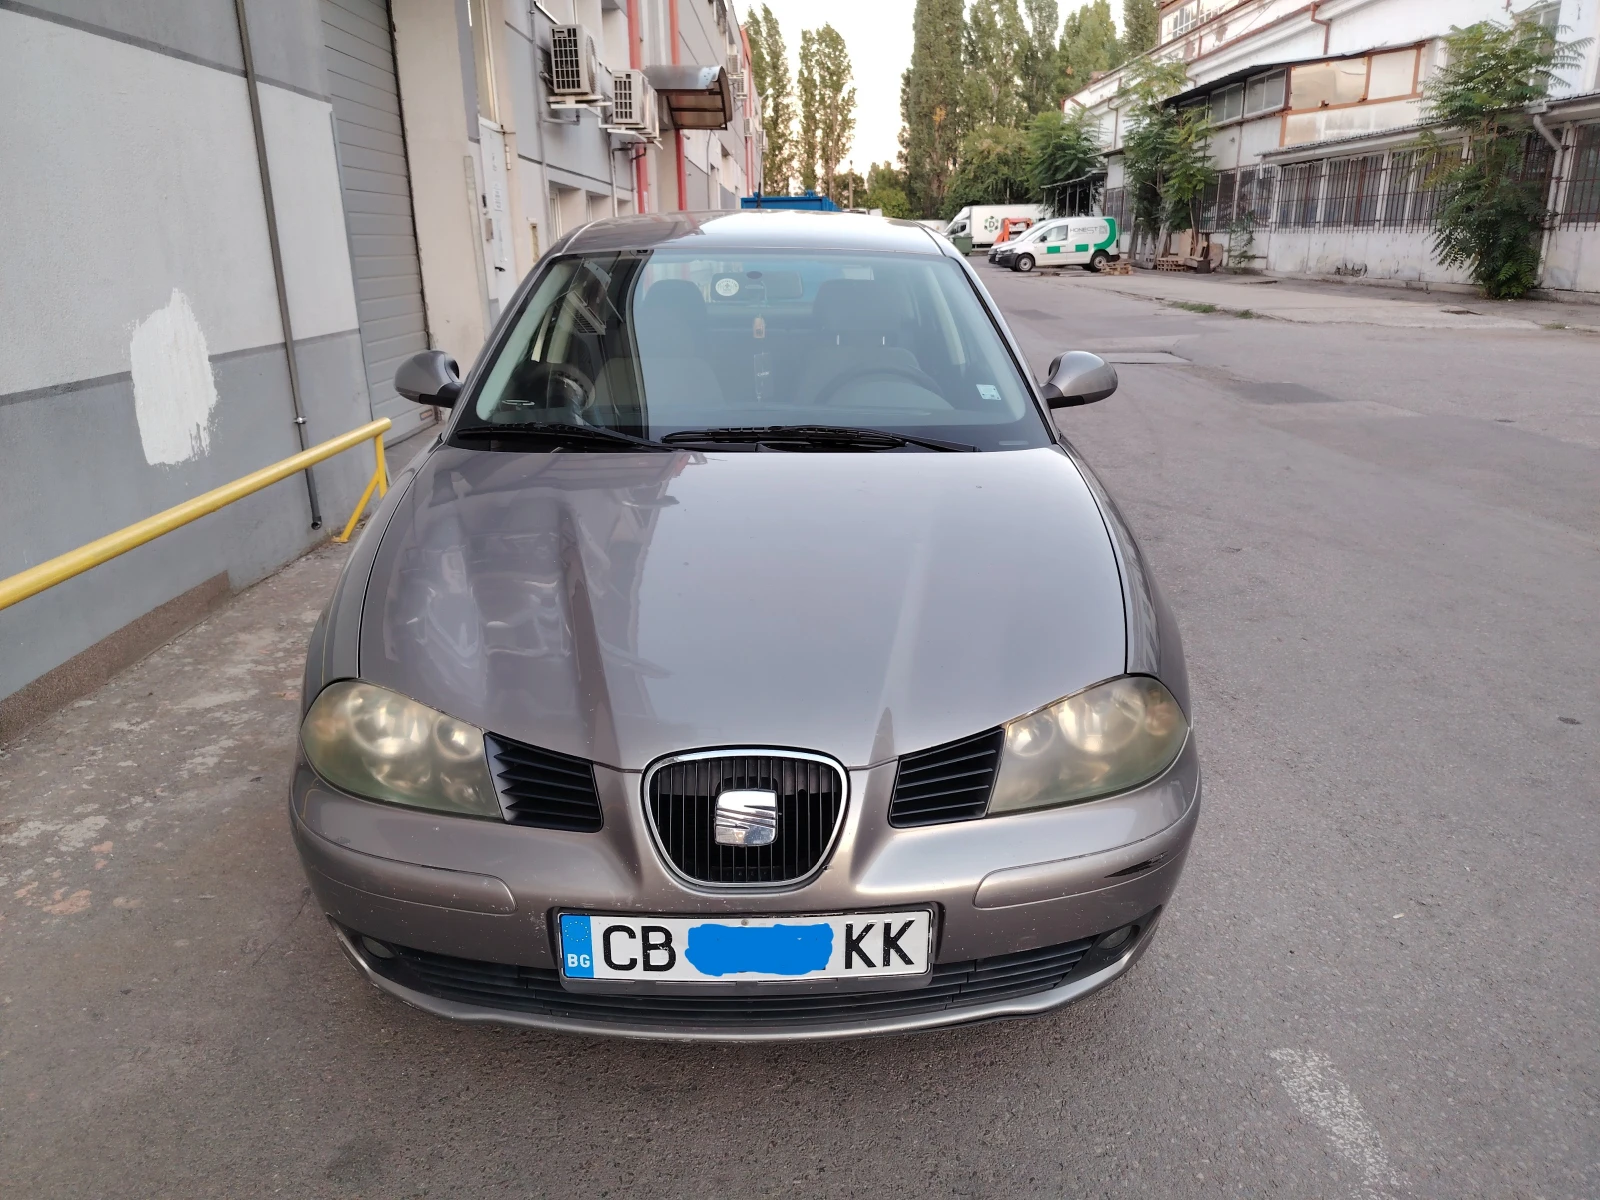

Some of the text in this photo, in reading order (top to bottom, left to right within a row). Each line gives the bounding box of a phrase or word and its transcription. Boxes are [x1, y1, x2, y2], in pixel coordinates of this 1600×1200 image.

[1069, 226, 1098, 234] HONEST
[602, 924, 677, 972] CB
[844, 919, 916, 970] KK
[567, 953, 591, 968] BG
